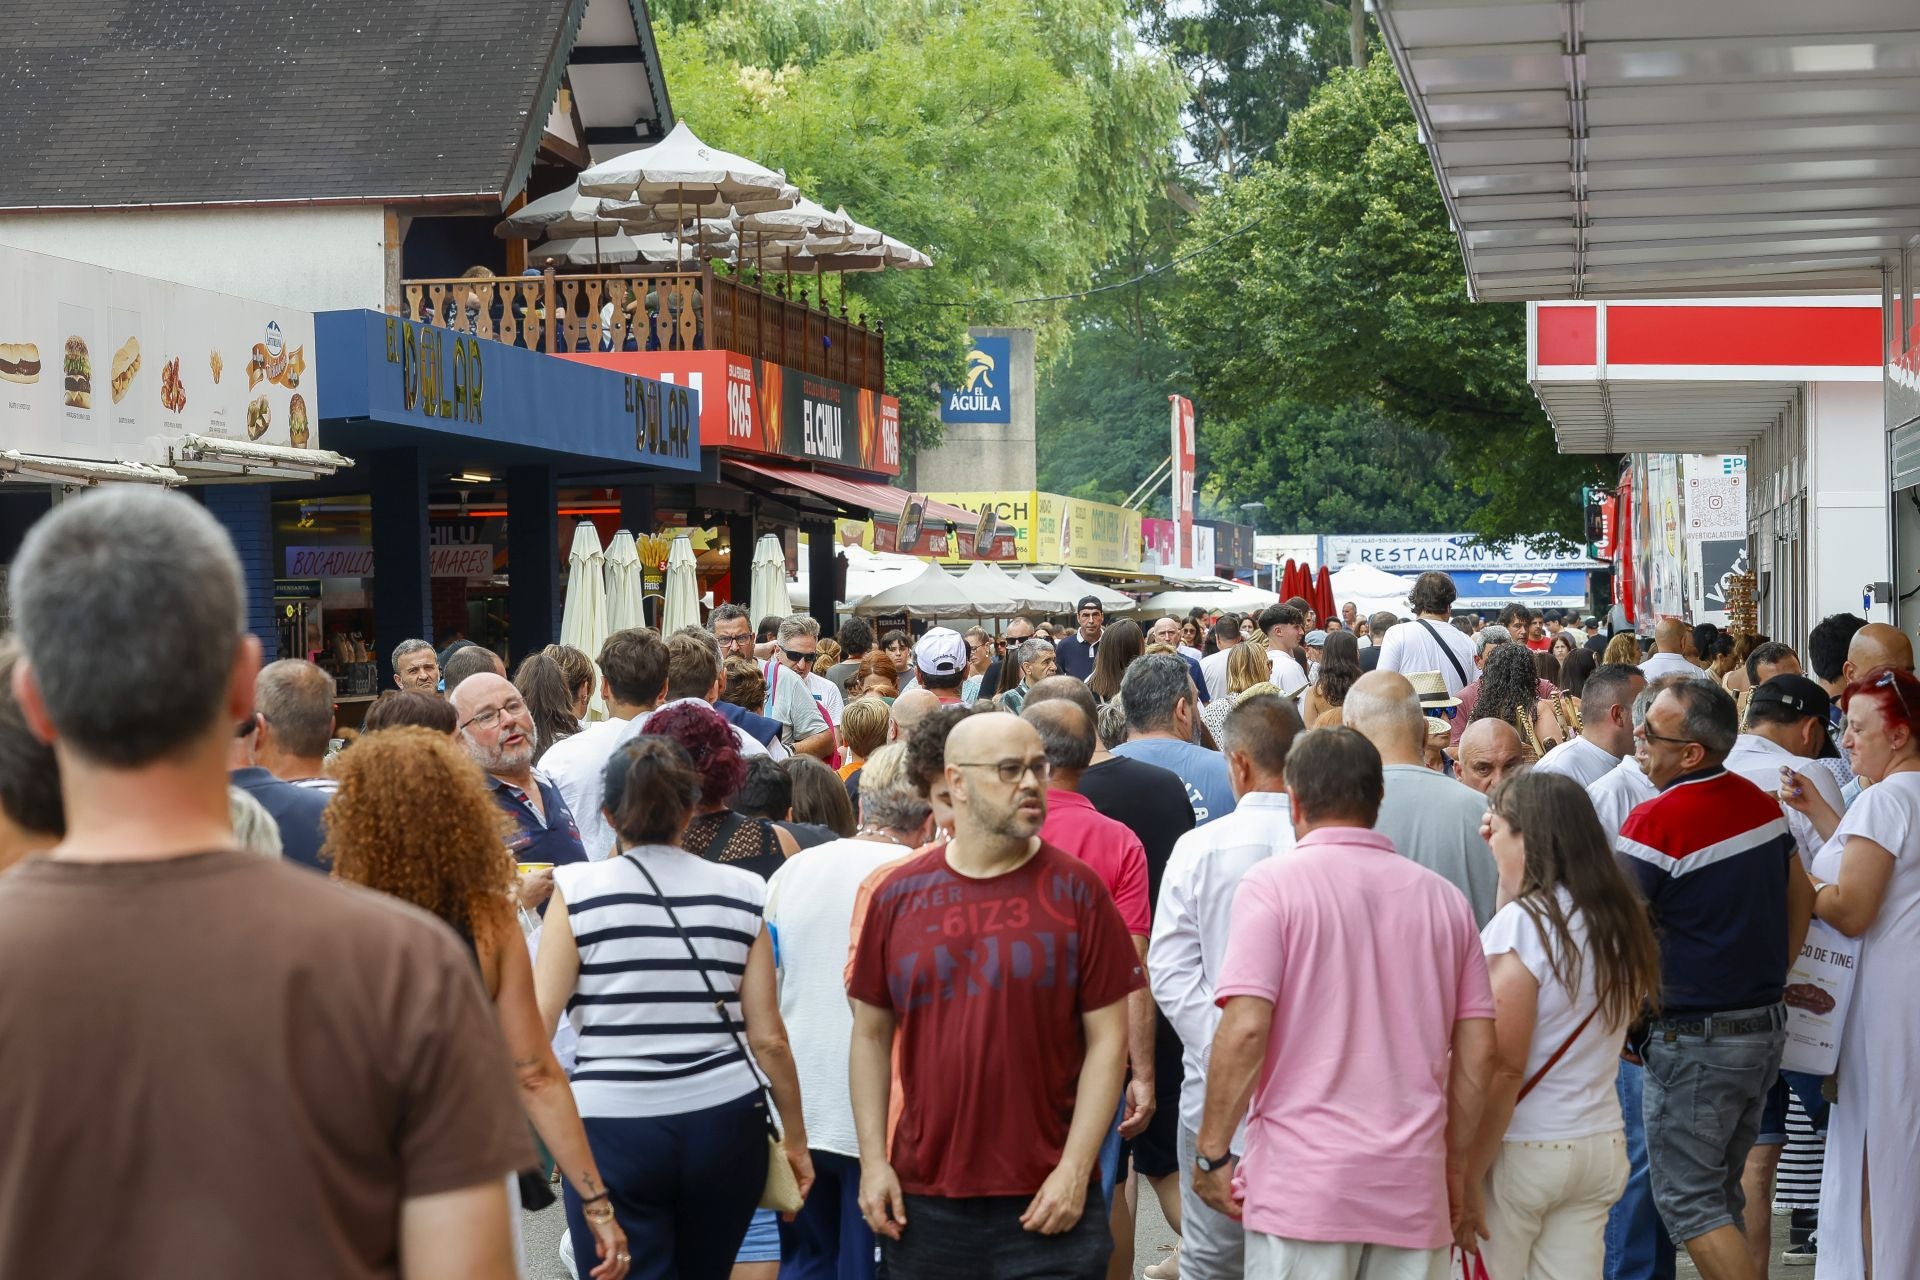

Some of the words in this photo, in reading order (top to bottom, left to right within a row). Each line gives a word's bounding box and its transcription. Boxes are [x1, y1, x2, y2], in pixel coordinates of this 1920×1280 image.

[386, 318, 400, 364] EL
[625, 376, 634, 413] EL
[949, 393, 1002, 412] ÁGUILA
[974, 387, 984, 396] EL
[727, 380, 752, 439] 1965
[803, 399, 816, 455] EL
[816, 403, 841, 460] CHILU
[882, 418, 898, 466] 1965
[644, 582, 660, 590] FRITAS
[1478, 572, 1558, 584] PEPSI
[1814, 947, 1829, 962] DE
